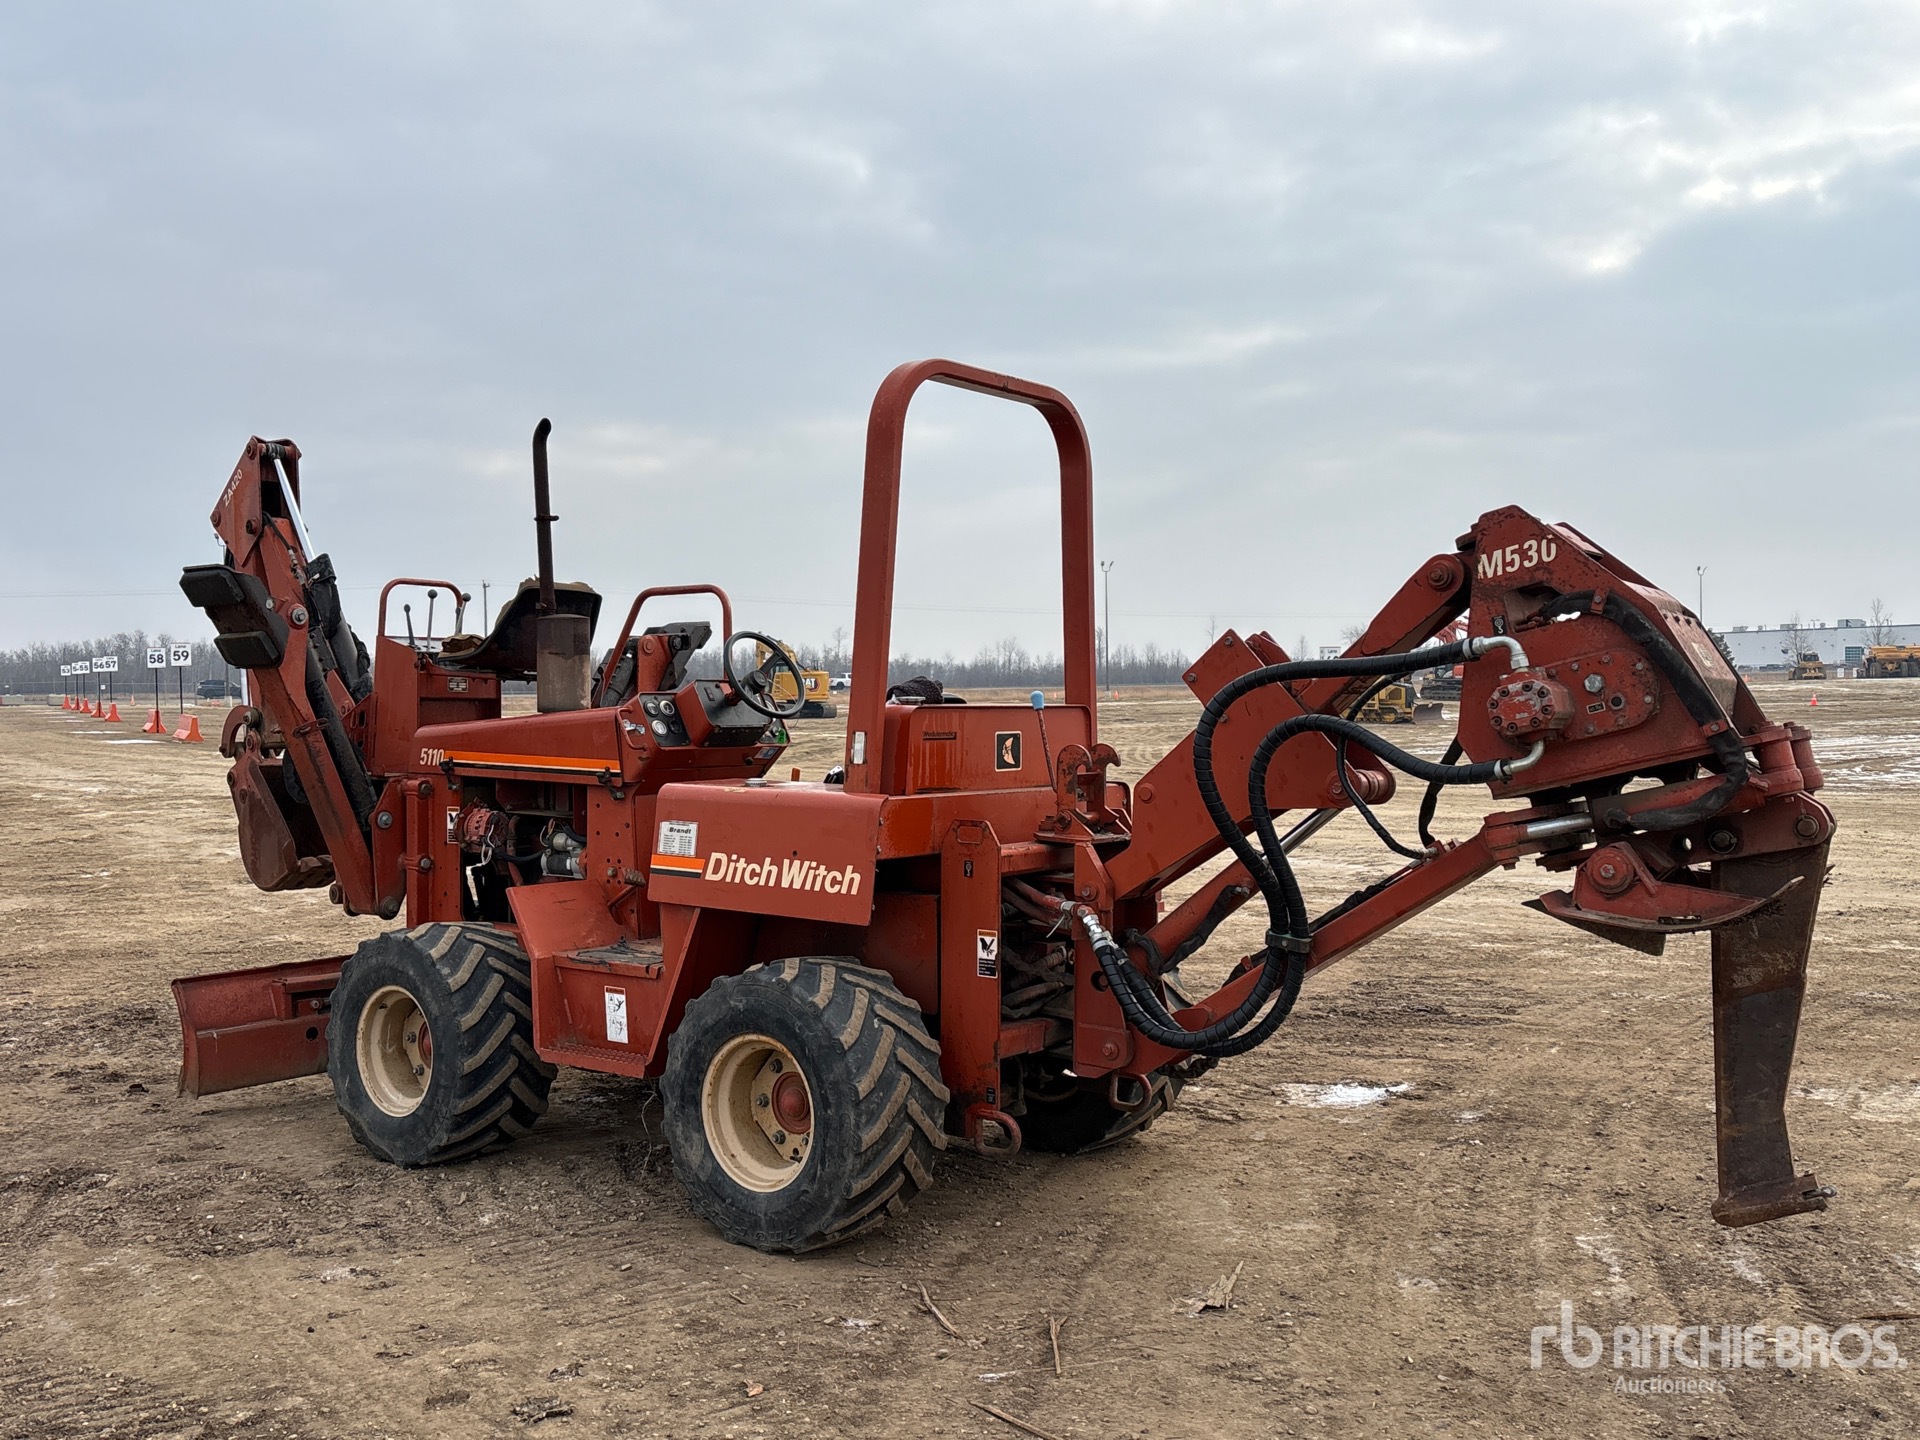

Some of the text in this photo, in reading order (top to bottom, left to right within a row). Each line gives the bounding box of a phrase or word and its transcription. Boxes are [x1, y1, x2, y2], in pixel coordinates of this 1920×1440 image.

[1478, 534, 1557, 579] M530
[149, 653, 164, 664] 58
[173, 650, 189, 661] 59
[94, 661, 104, 669] 56
[105, 660, 117, 669] 57
[420, 747, 445, 766] 5110
[669, 826, 692, 834] Brandt
